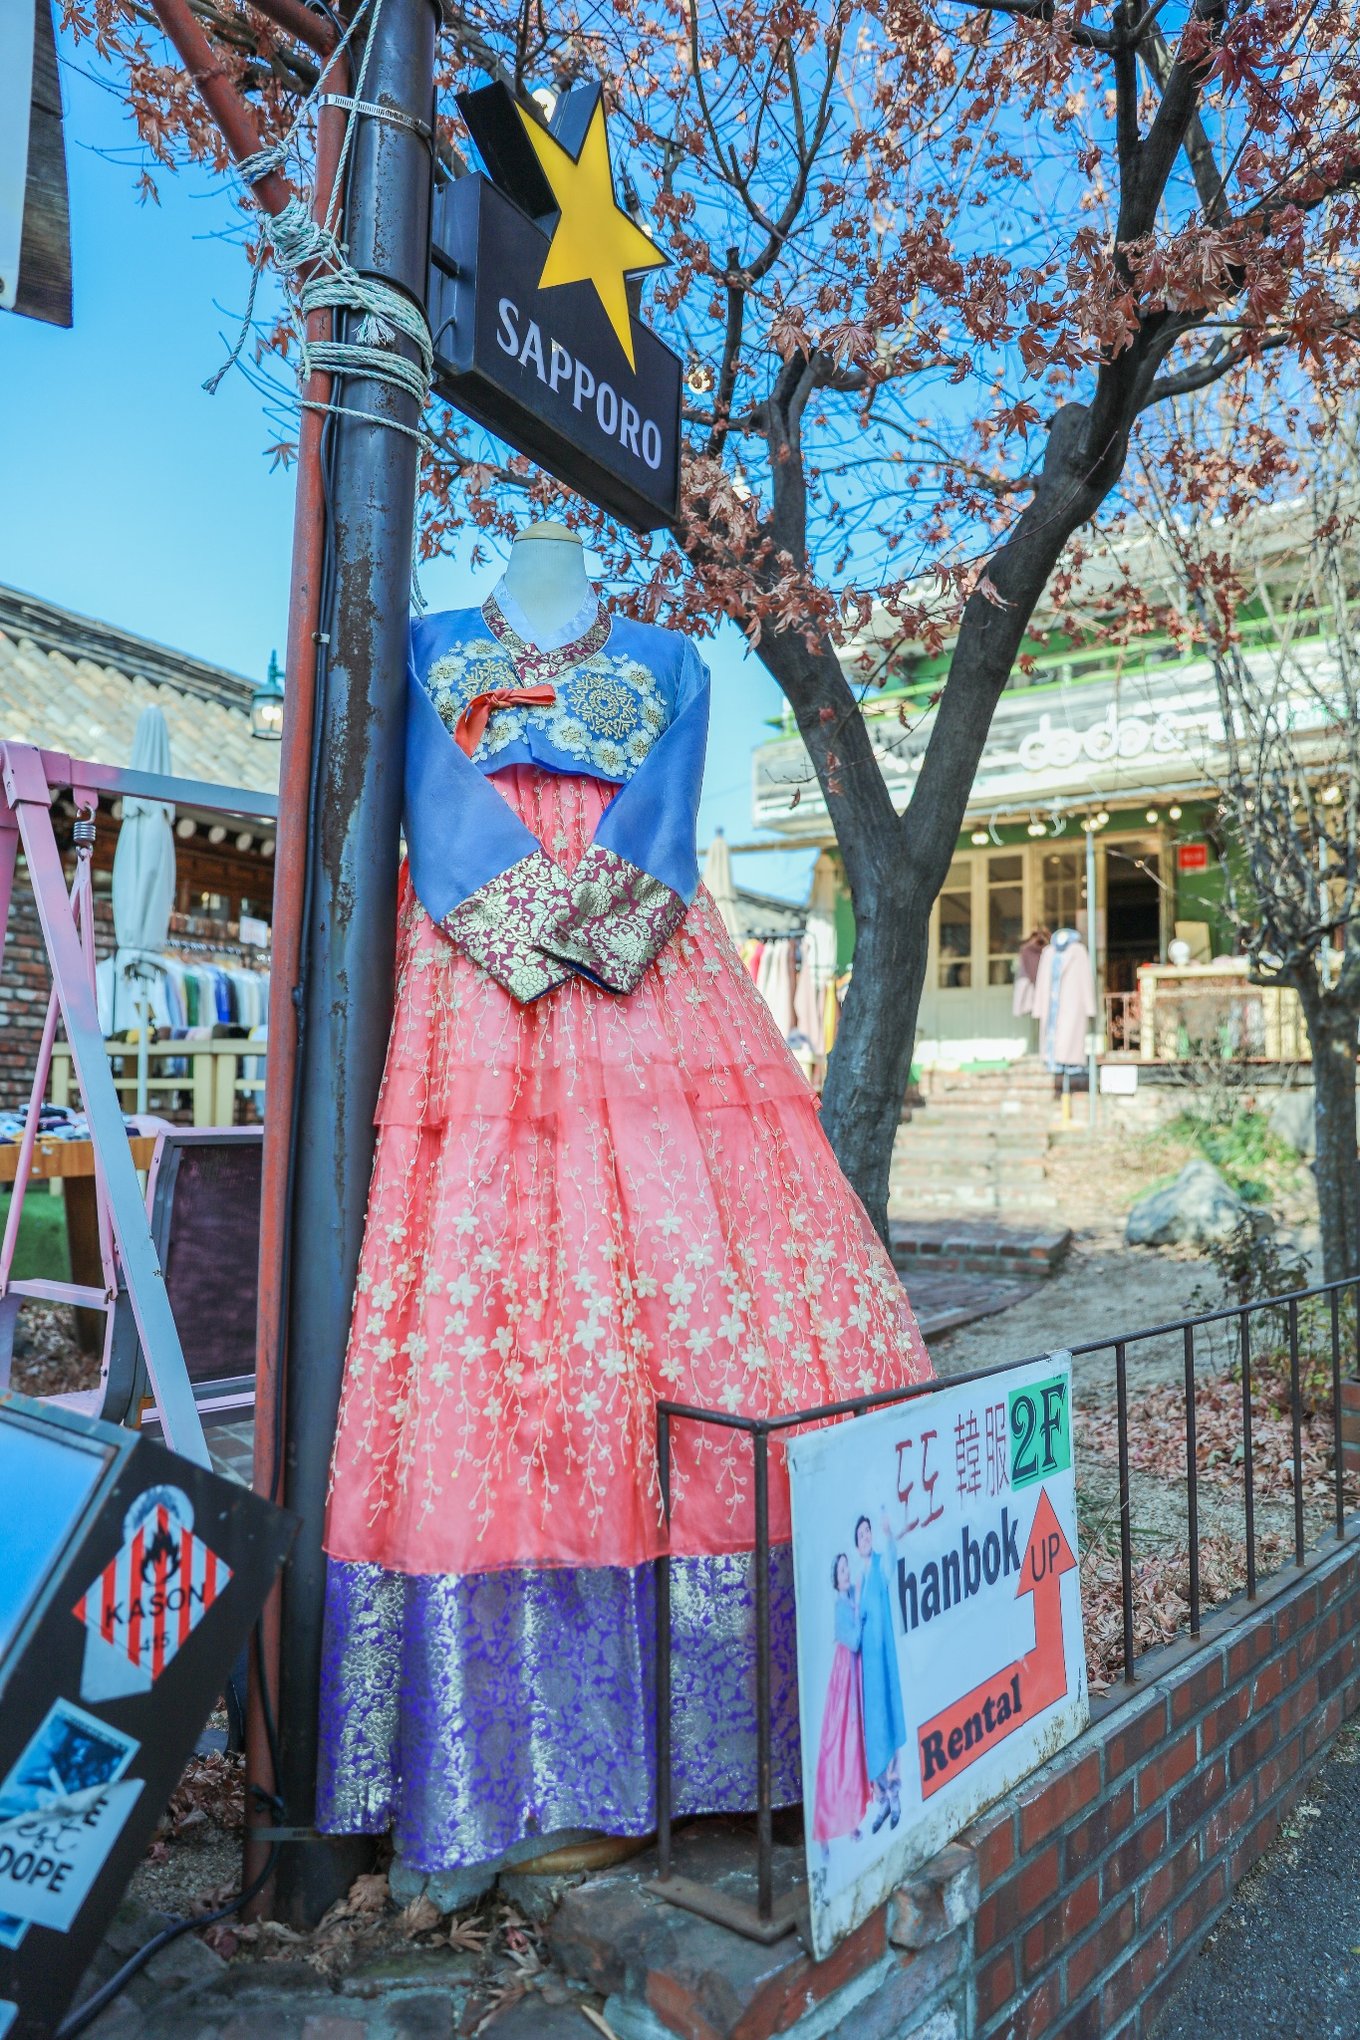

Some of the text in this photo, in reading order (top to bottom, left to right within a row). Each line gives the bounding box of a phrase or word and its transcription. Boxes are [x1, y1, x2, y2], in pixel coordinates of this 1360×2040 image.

[496, 297, 662, 471] SAPPORO
[953, 1402, 1011, 1510] 韓服
[1010, 1382, 1067, 1486] 2F
[105, 1583, 206, 1629] KASON
[897, 1506, 1021, 1634] hanbok
[1031, 1532, 1061, 1582] UP
[920, 1672, 1023, 1783] Rental
